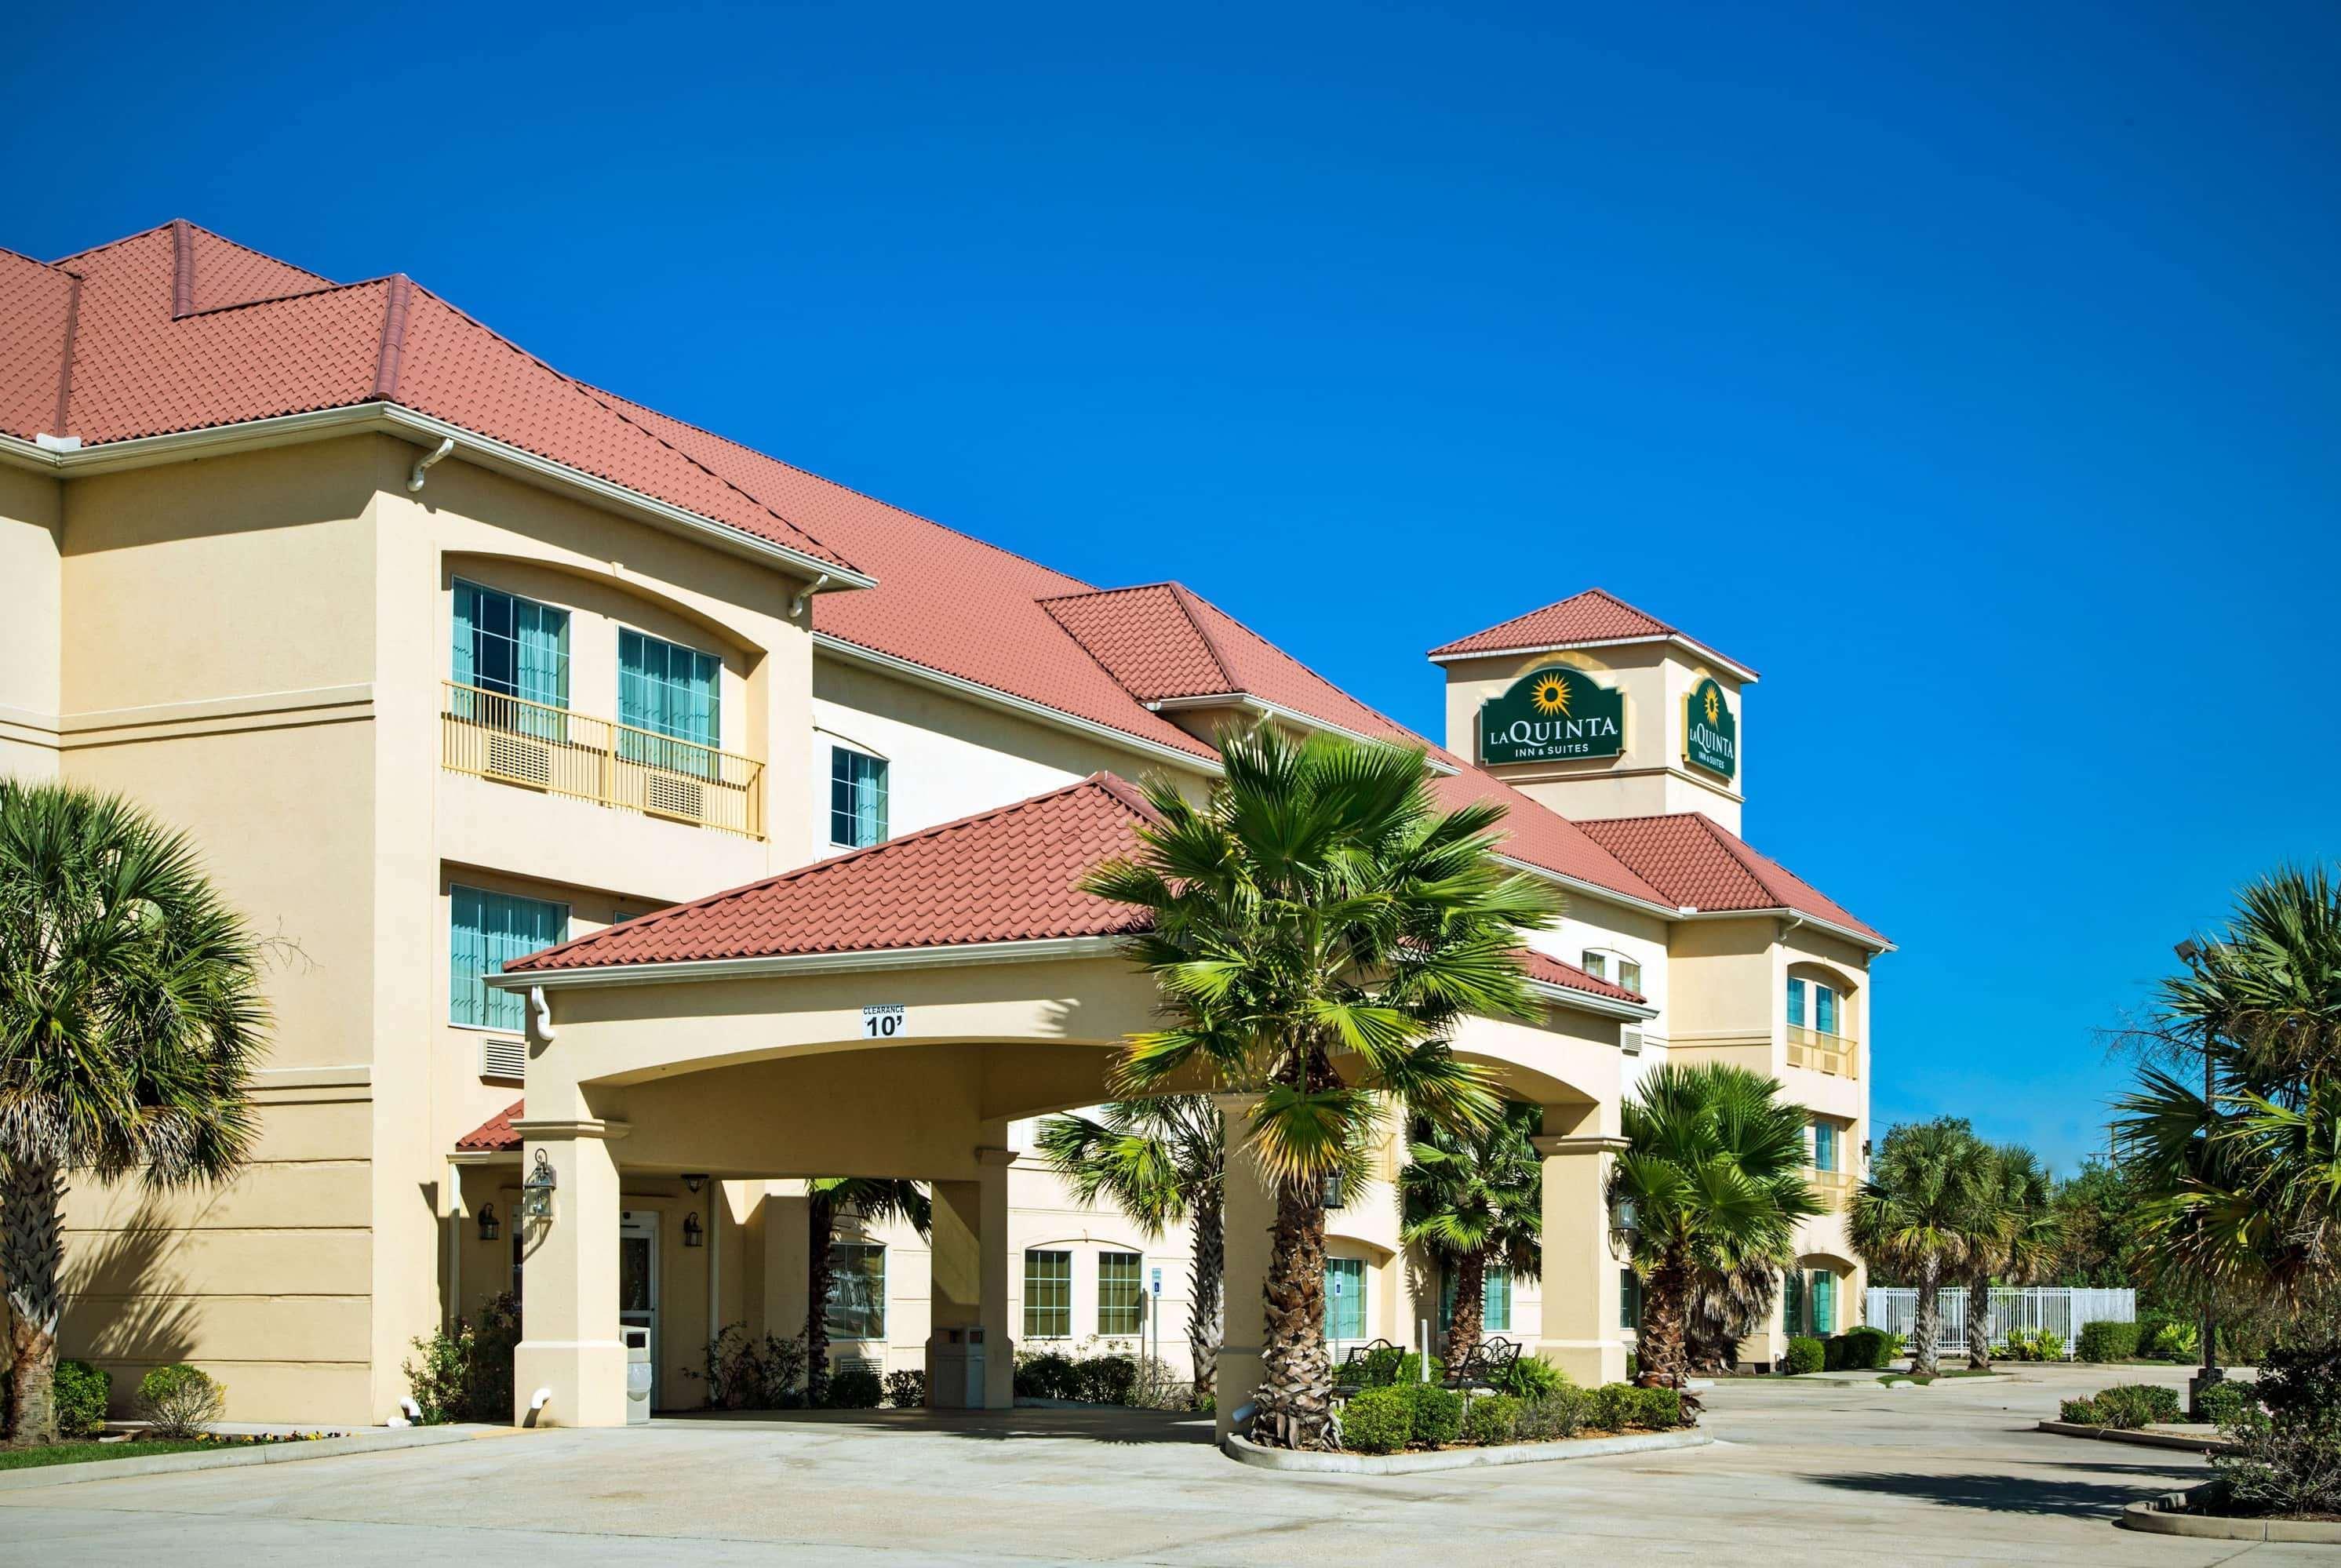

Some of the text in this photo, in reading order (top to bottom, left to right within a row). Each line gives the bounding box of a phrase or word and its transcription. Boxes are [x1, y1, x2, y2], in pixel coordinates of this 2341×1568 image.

[1491, 716, 1618, 747] LA QUINTA
[1689, 722, 1734, 759] LA QUINTA
[1515, 748, 1535, 758] INN
[1547, 743, 1589, 755] SUITES
[1709, 755, 1724, 769] SUITES
[863, 1005, 905, 1015] CLEARANCE
